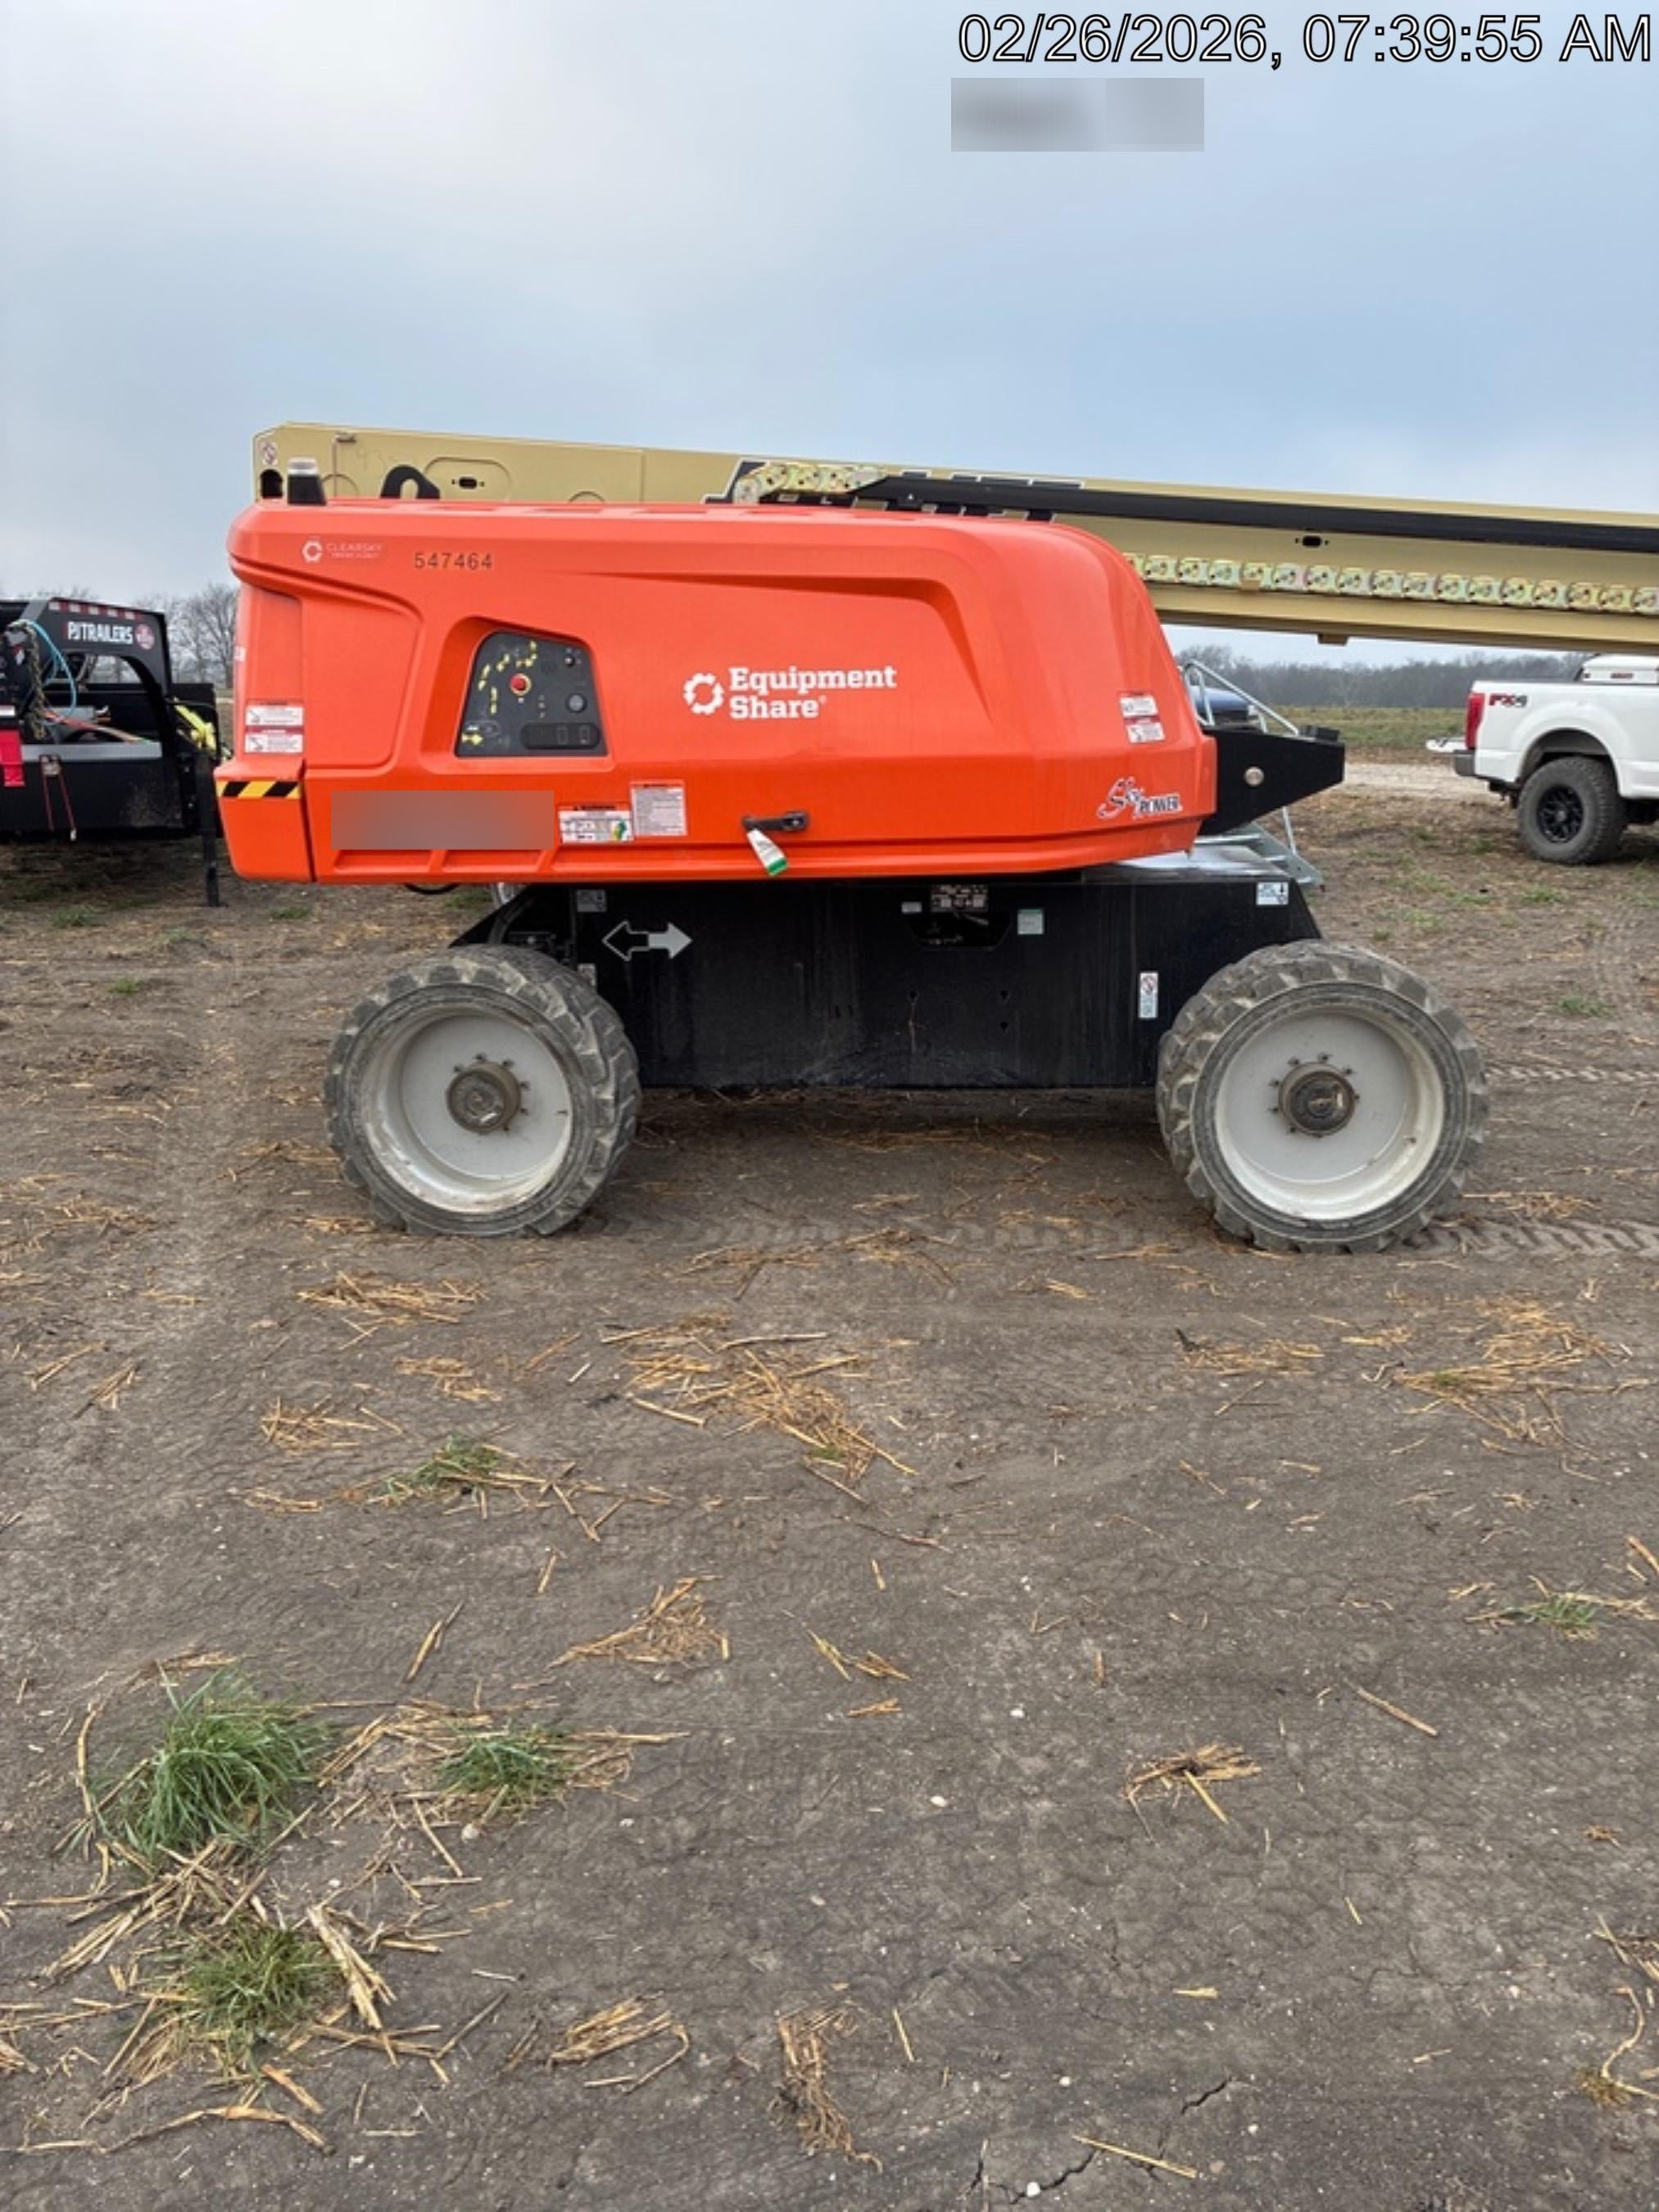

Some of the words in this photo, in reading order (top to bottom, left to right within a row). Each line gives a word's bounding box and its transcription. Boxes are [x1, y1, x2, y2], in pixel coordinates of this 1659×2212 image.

[414, 551, 493, 570] 547464
[728, 665, 897, 696] Equipment
[1489, 693, 1529, 708] FX4
